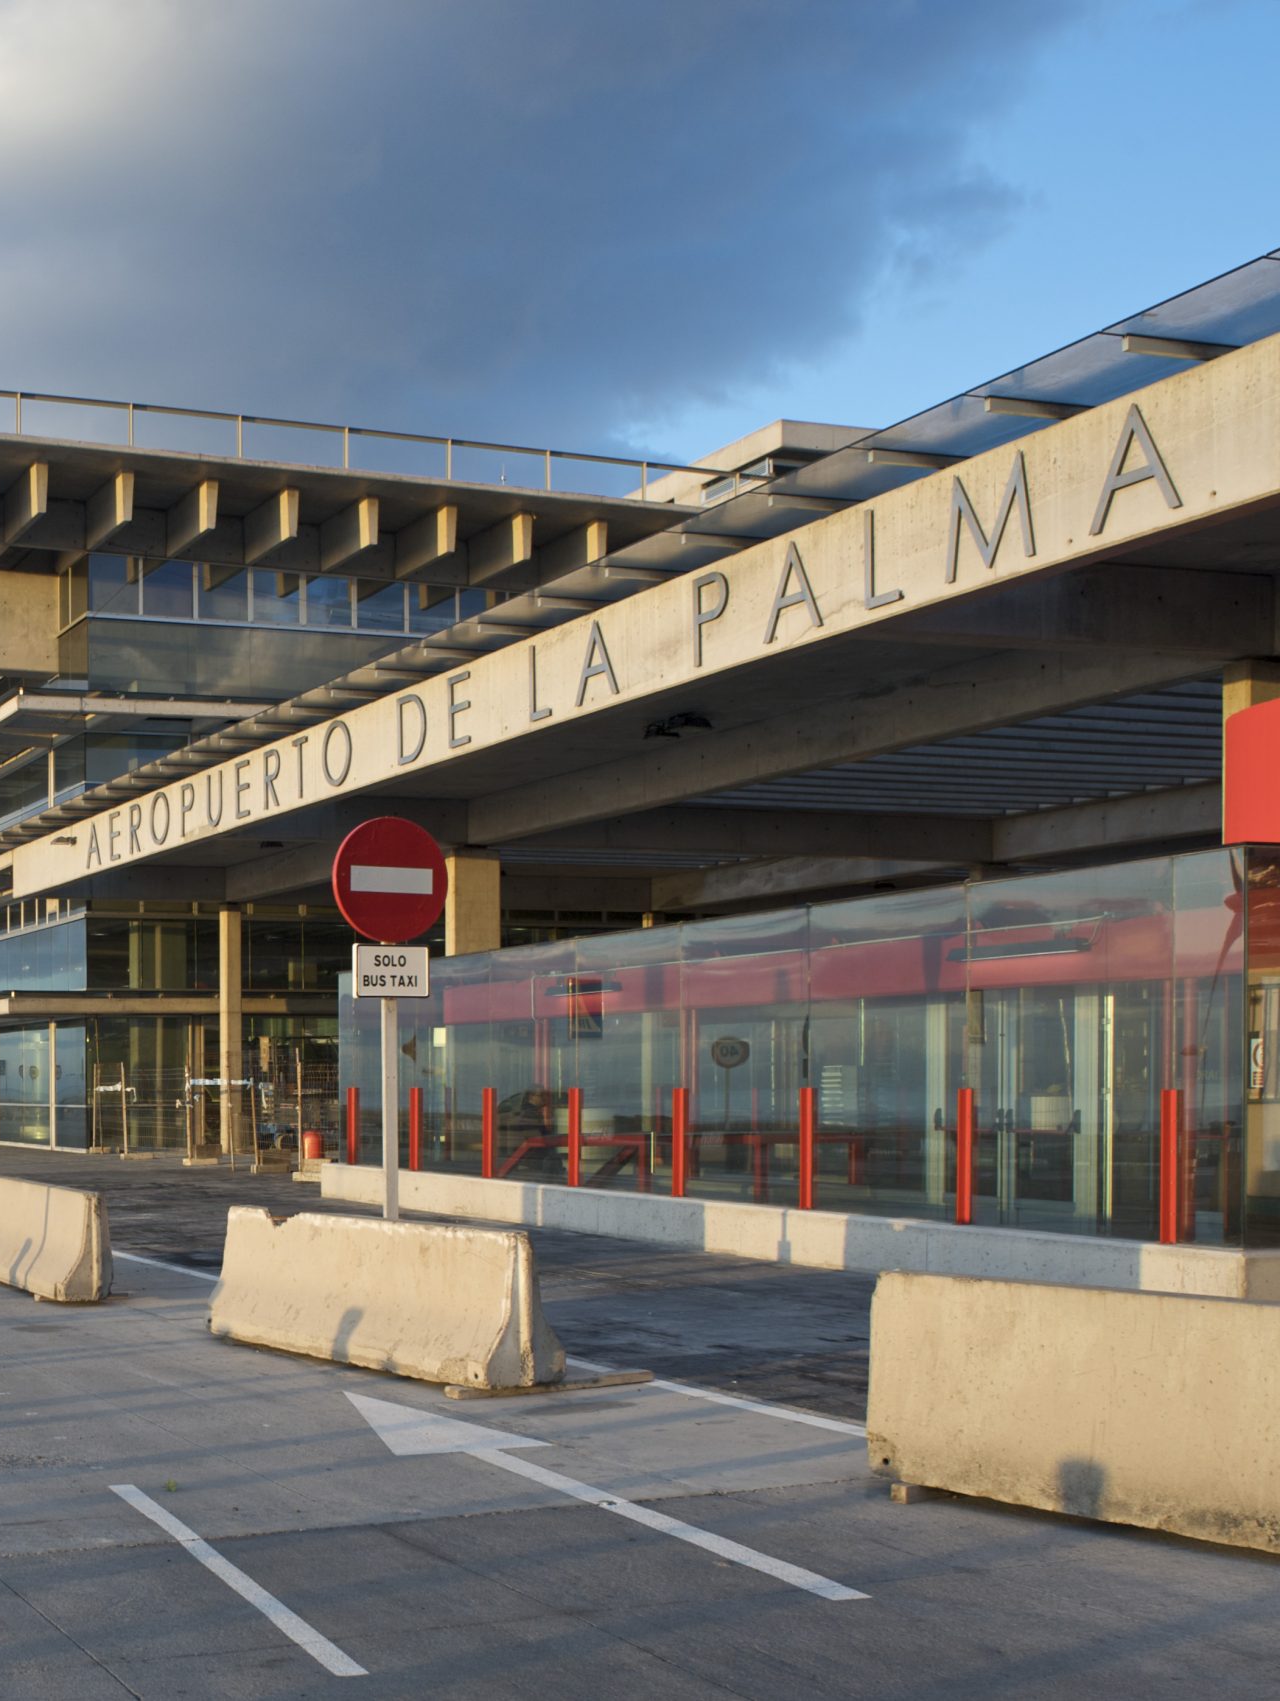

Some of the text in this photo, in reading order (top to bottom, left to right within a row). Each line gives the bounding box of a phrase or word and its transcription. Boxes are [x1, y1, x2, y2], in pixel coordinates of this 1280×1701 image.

[86, 402, 1182, 869] AEROPUERTO DE LA PALMA
[374, 955, 406, 967] SOLO
[363, 975, 418, 988] BUS TAXI
